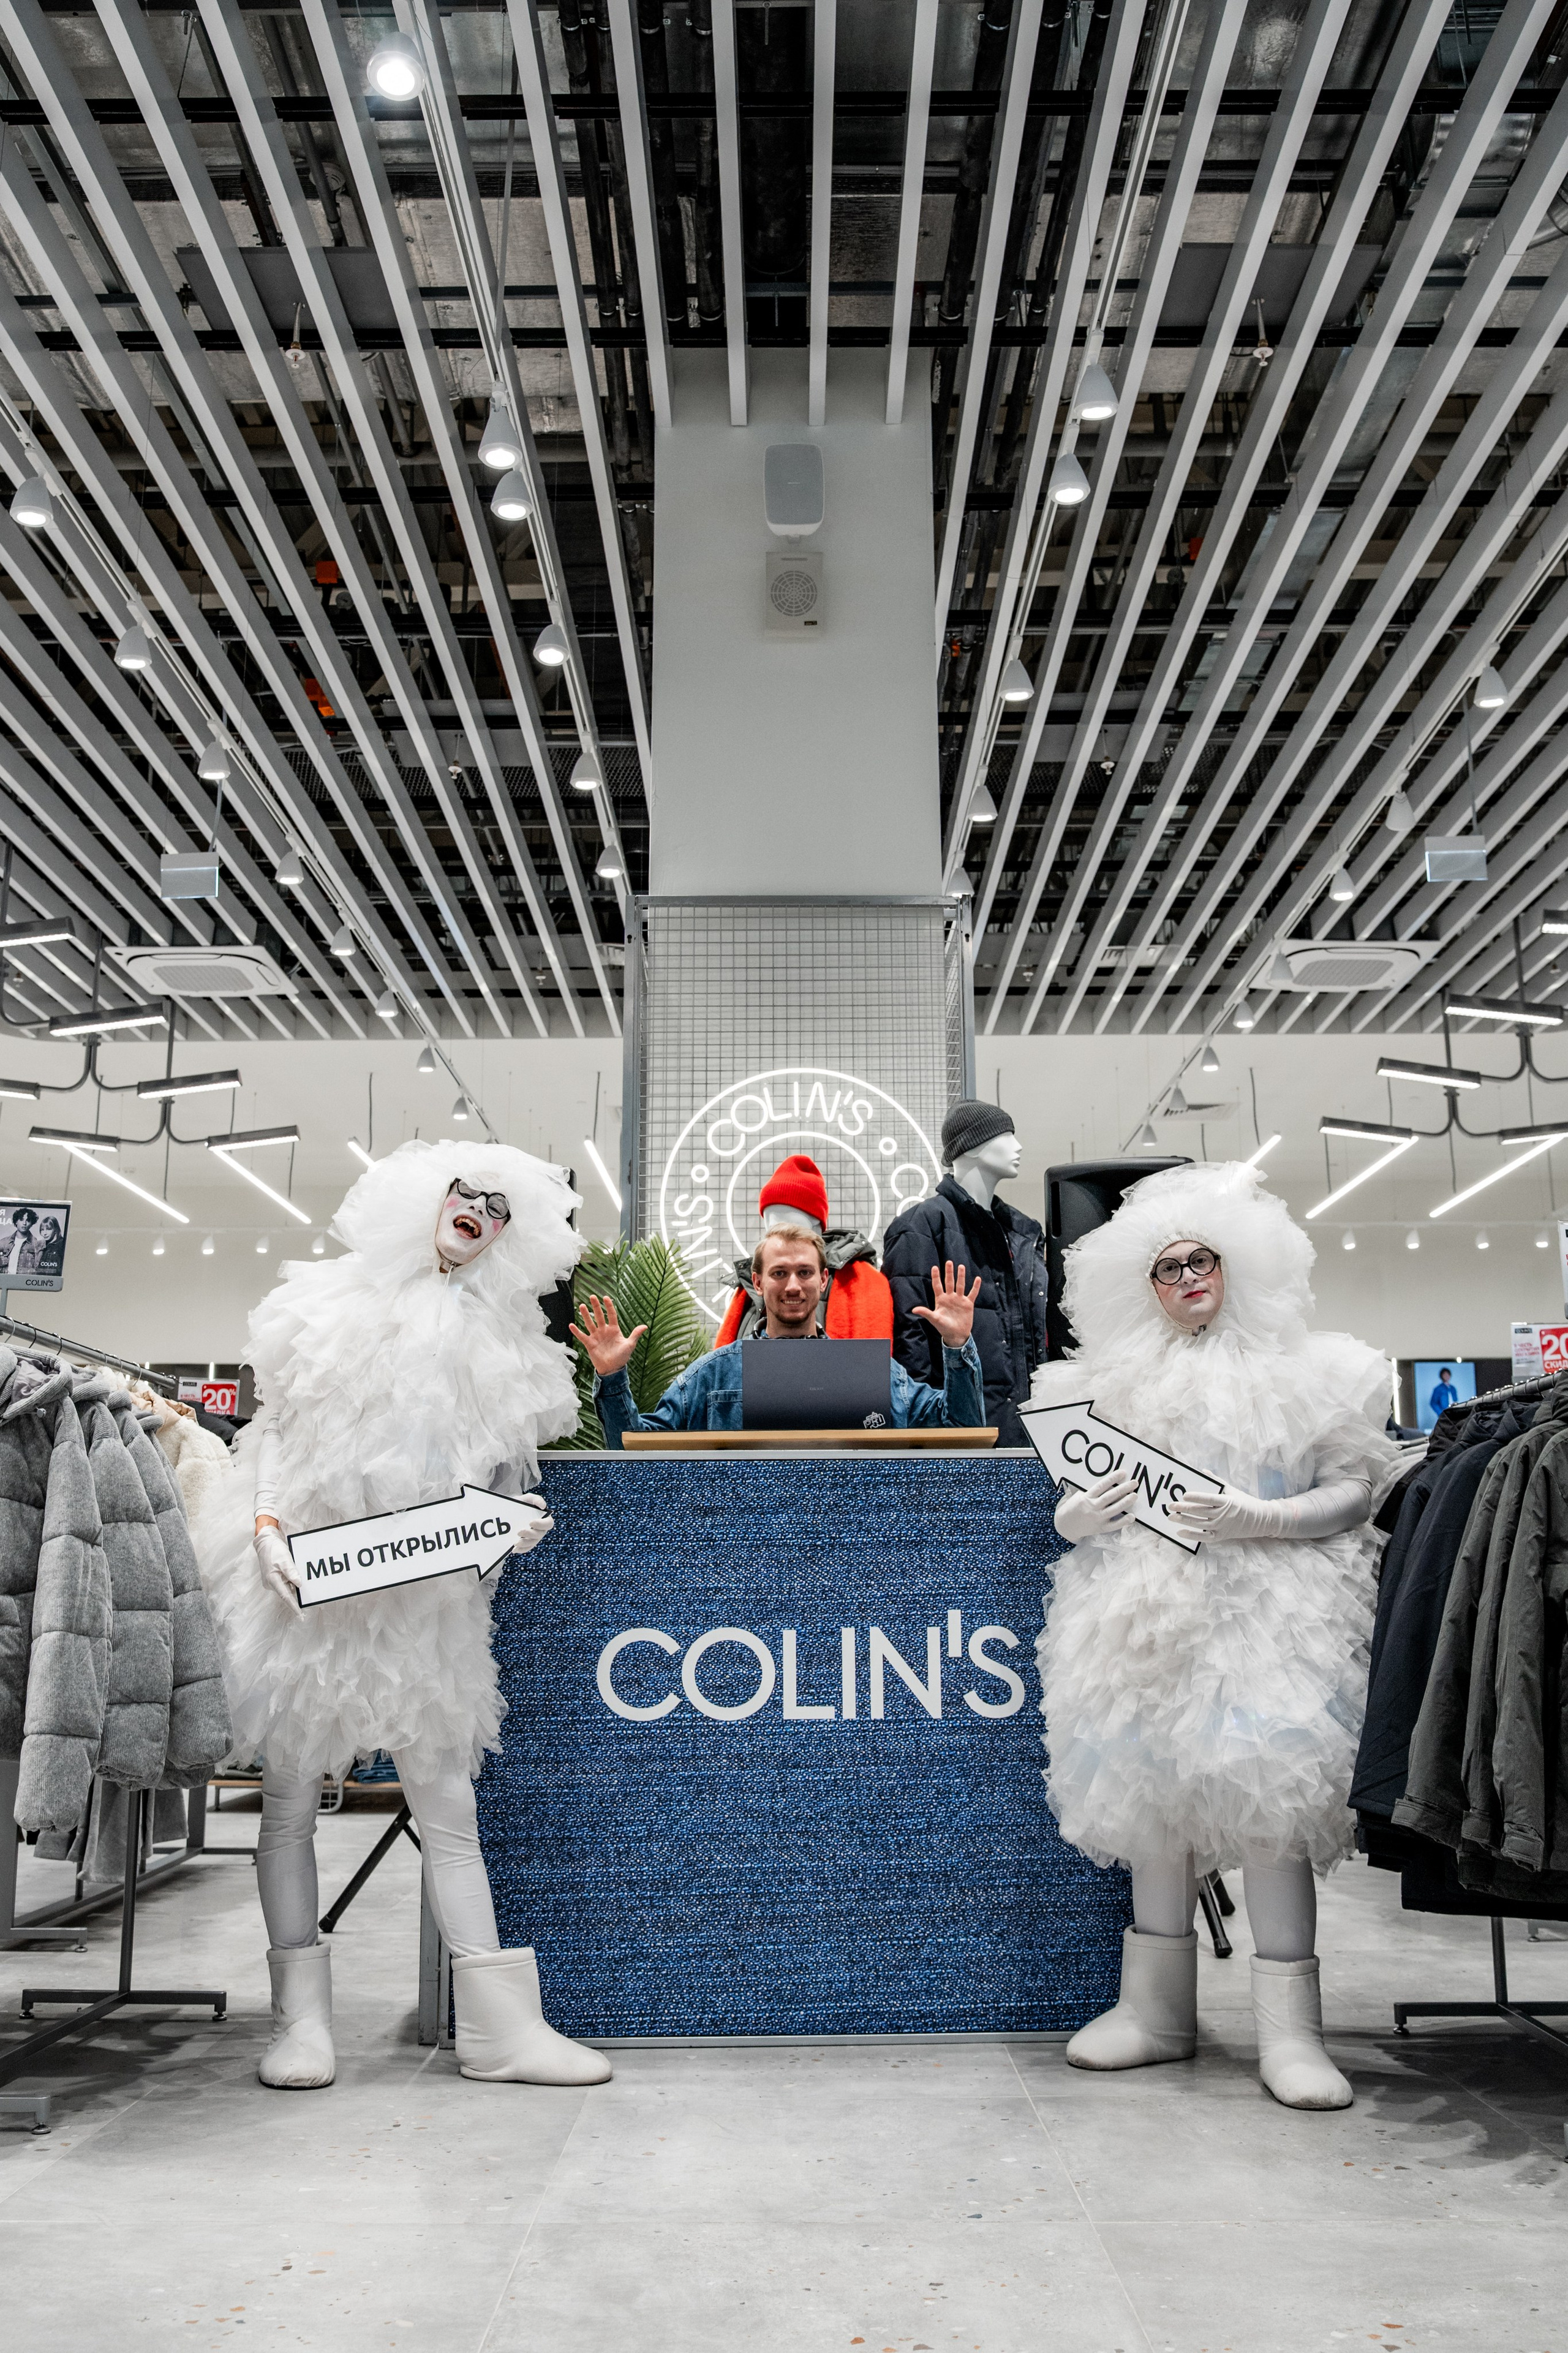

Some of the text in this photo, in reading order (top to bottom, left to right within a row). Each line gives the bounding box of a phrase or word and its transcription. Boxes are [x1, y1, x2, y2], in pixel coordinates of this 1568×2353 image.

[707, 1081, 873, 1156] COLIN'S
[671, 1193, 737, 1309] LIN'S
[306, 1516, 511, 1581] МЫ ОТКРЫЛИСЬ
[597, 1609, 1025, 1721] COLIN'S
